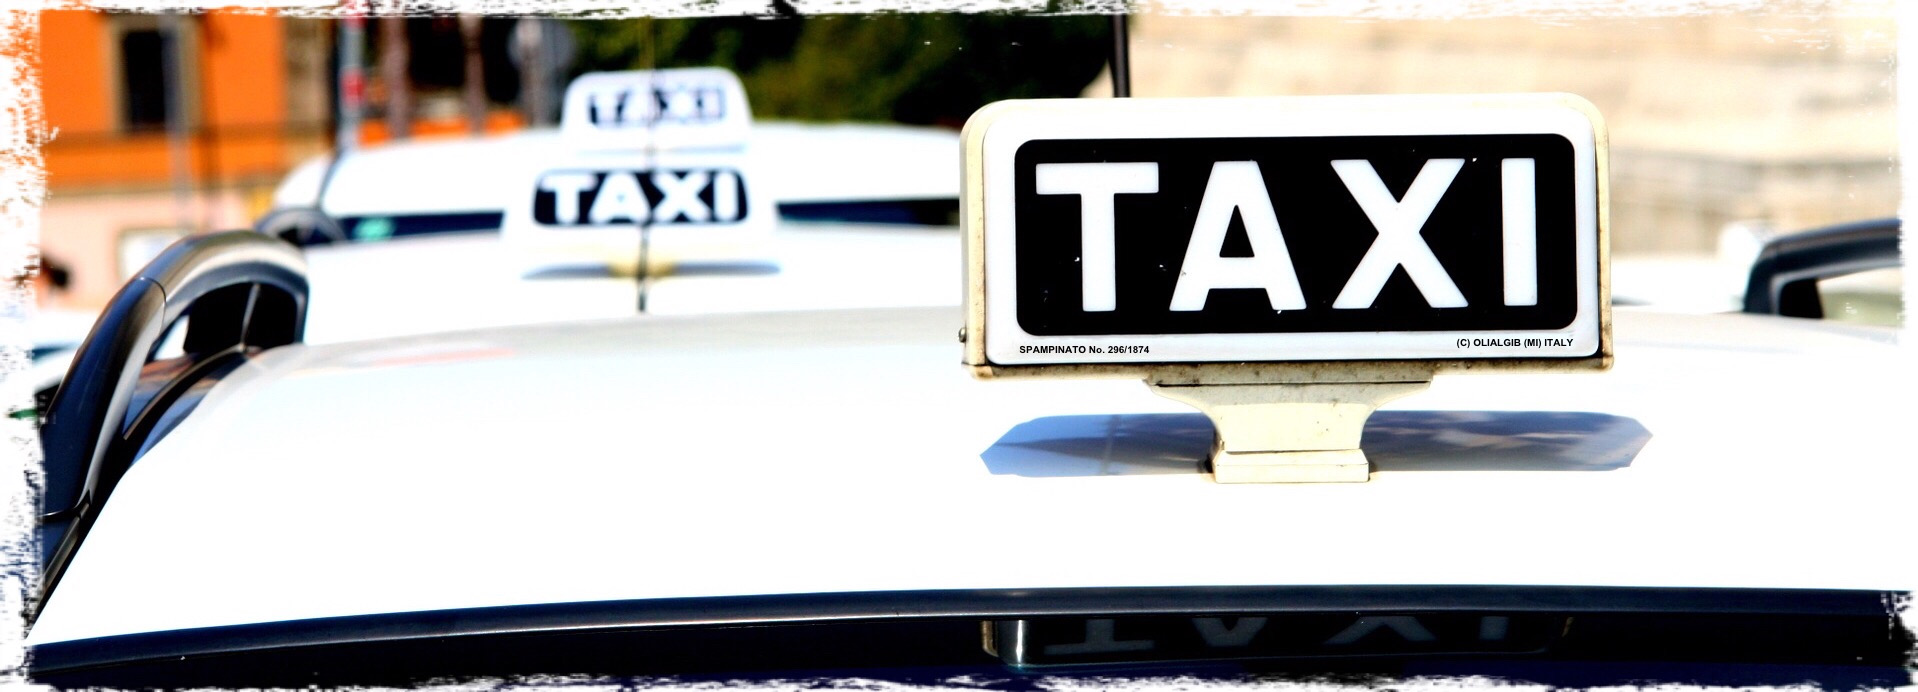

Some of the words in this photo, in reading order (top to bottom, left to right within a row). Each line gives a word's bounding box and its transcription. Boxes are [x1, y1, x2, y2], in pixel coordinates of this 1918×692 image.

[540, 171, 739, 223] TAXI
[1036, 158, 1538, 312] TAXI
[1019, 345, 1086, 354] SPAMPINATO
[1089, 345, 1105, 354] No.
[1108, 345, 1150, 354] 296/1874
[1456, 338, 1471, 348] (C)
[1473, 338, 1521, 347] OLIALGIB
[1524, 338, 1542, 348] (MI)
[1544, 338, 1574, 347] ITALY
